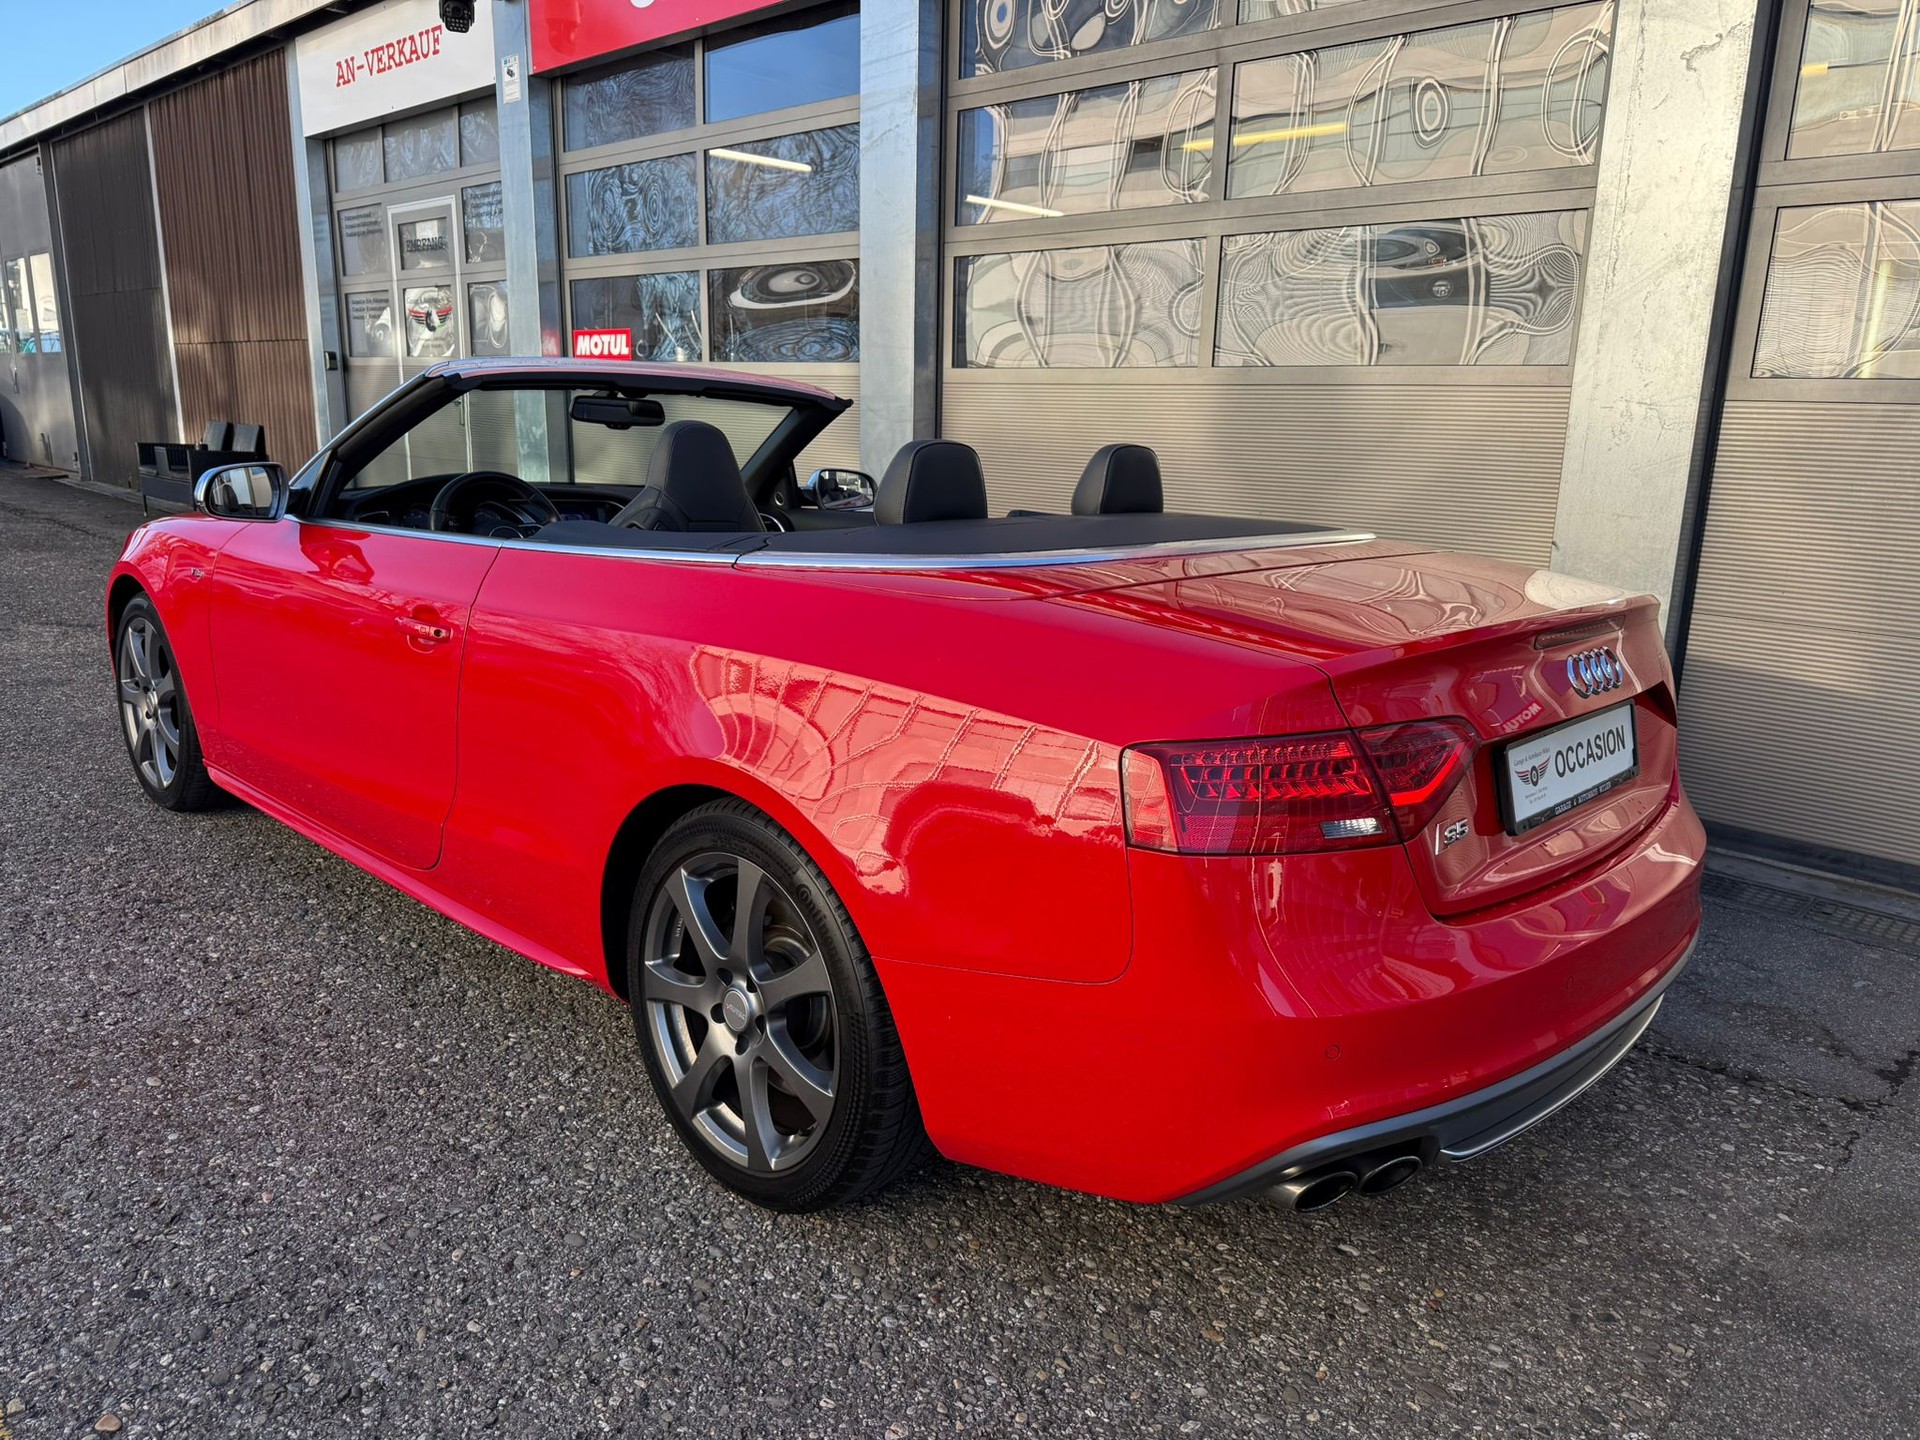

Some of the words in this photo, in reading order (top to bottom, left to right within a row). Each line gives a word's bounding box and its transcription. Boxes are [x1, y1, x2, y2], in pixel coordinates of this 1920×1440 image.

[336, 25, 443, 87] AN-VERKAUF
[576, 334, 629, 356] MOTUL
[1554, 725, 1626, 778] OCCASION
[1554, 801, 1572, 815] GARAGE
[1444, 818, 1469, 846] S5
